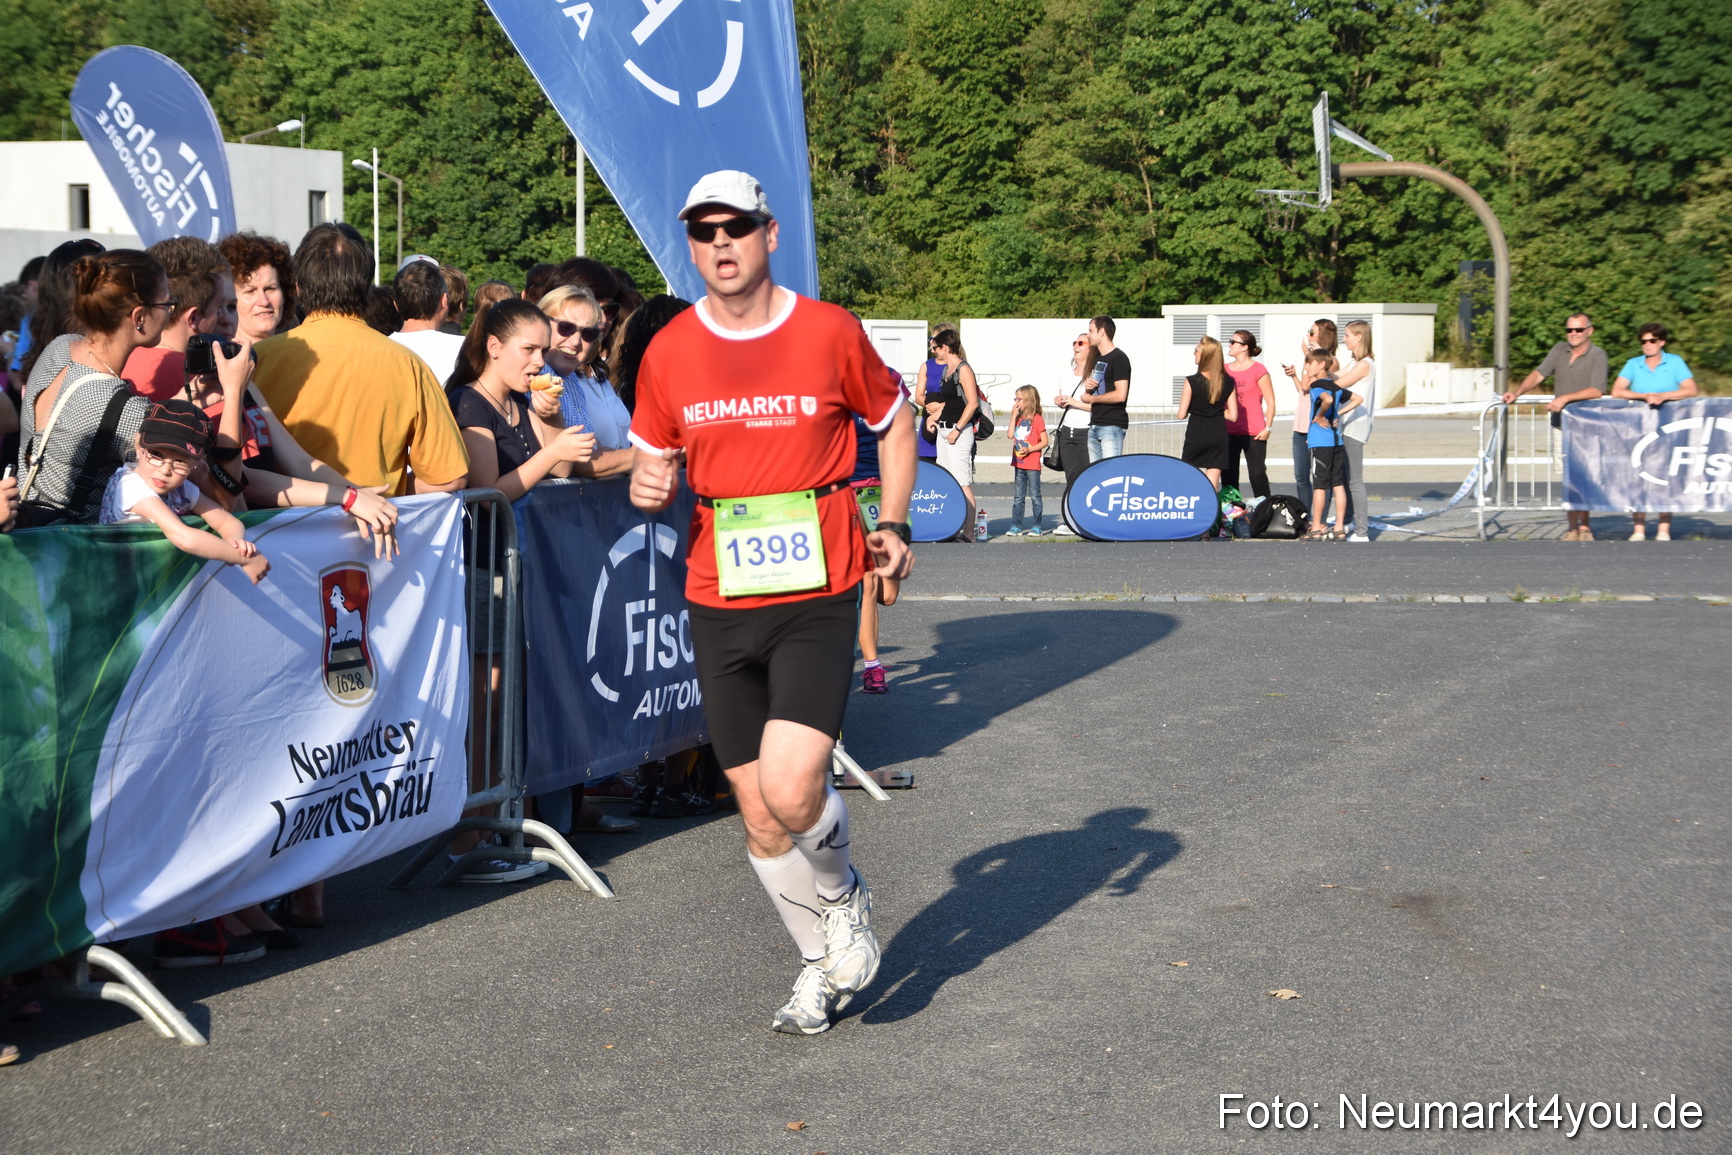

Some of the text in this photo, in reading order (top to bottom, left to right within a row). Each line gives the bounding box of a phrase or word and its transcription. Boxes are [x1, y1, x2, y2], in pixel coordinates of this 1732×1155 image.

[683, 395, 796, 423] NEUMARKT
[745, 420, 773, 428] STARKE
[212, 463, 236, 489] SONY
[1107, 491, 1200, 511] Fischer
[1118, 511, 1194, 521] AUTOMOBILE
[727, 532, 811, 567] 1398
[335, 672, 365, 694] 1628
[287, 719, 416, 784] Neumarkter
[269, 762, 435, 858] Lammsbräu
